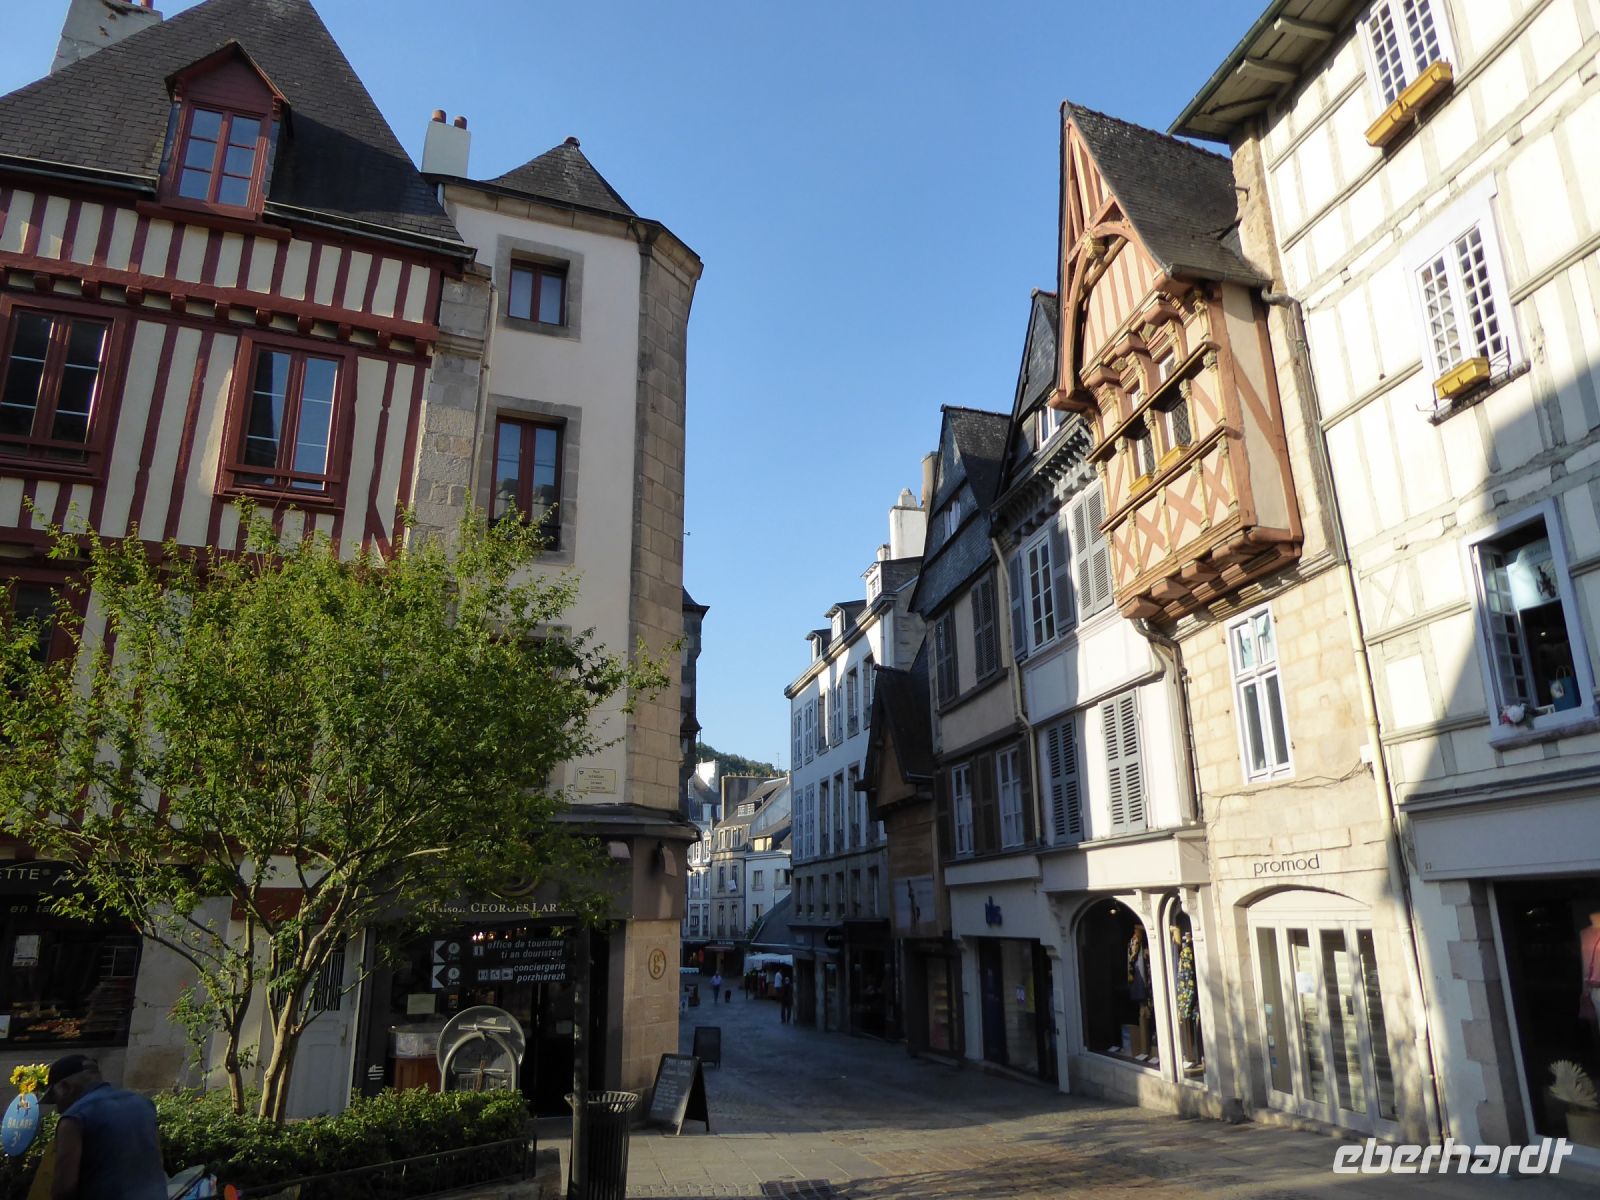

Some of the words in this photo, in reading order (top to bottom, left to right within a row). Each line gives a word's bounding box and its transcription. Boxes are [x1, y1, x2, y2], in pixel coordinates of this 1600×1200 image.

[1253, 853, 1320, 878] promod
[0, 868, 41, 880] TTE
[487, 940, 512, 950] office
[515, 940, 525, 948] de
[528, 939, 565, 948] tourisme
[501, 950, 507, 959] ti
[523, 949, 563, 958] douristed
[513, 962, 566, 973] conciergerie
[516, 972, 566, 984] porzhierezh
